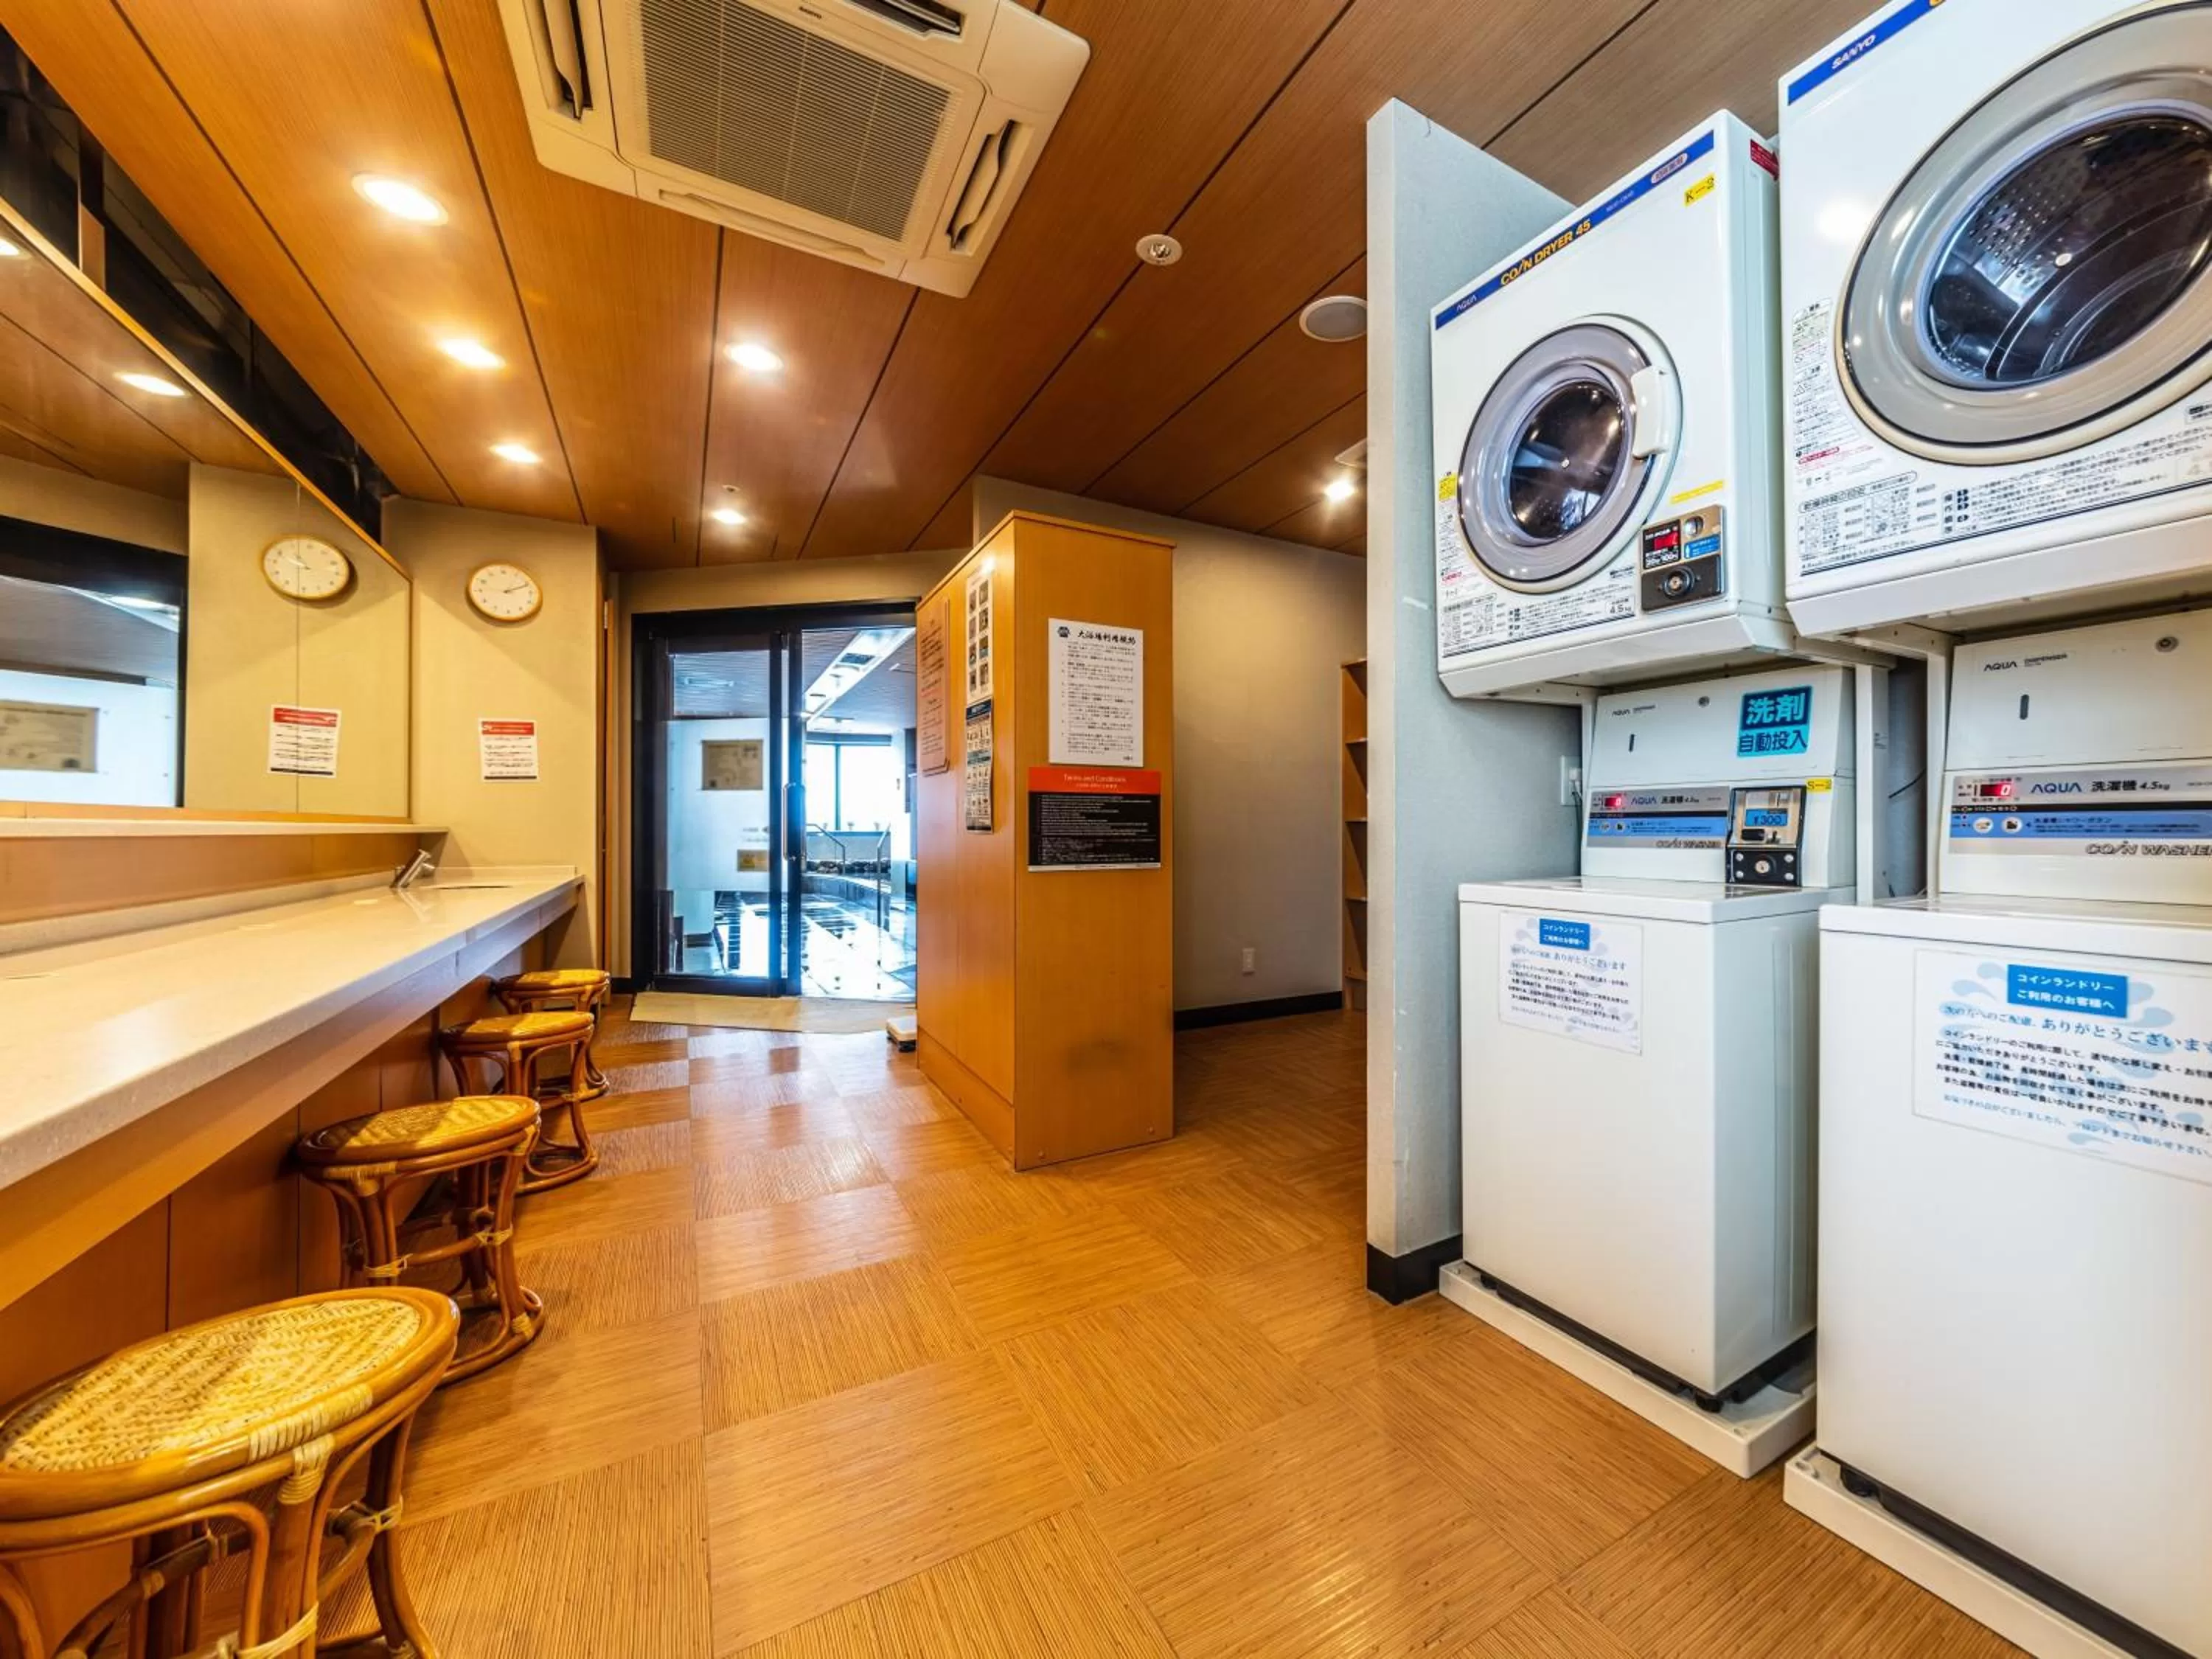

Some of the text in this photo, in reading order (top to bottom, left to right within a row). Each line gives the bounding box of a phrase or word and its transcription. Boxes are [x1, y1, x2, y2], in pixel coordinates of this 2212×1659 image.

[1832, 34, 1877, 69] SANYO
[1456, 295, 1477, 312] AQUA
[1534, 232, 1573, 264] DRYER
[1576, 219, 1591, 235] 45
[1983, 661, 2017, 672] AQUA
[1745, 692, 1806, 725] 洗剤
[1739, 728, 1808, 752] 自動投入
[2000, 784, 2011, 796] 0
[2031, 782, 2082, 793] AQUA
[2092, 780, 2137, 791] 洗濯機
[1630, 796, 1657, 805] AQUA
[2017, 973, 2115, 990] コインランドリー
[2017, 989, 2115, 1009] ご利用のお客様へ
